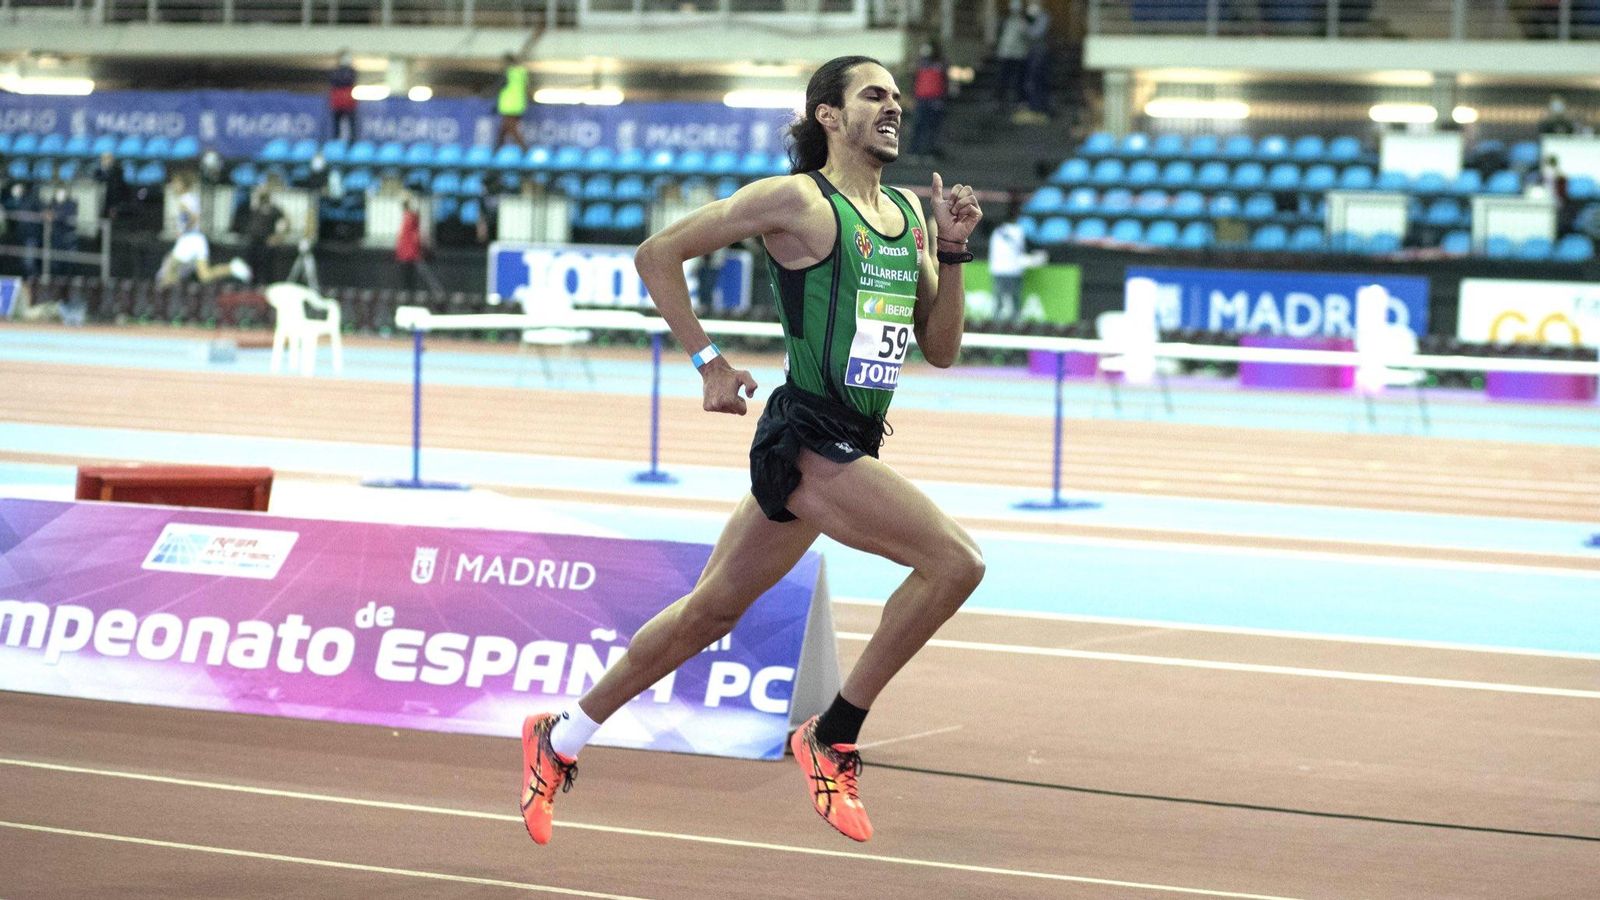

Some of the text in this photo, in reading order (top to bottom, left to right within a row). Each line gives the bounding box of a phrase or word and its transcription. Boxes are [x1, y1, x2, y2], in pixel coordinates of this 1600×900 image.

[860, 262, 913, 282] VILLARREAL
[878, 325, 909, 360] 59
[454, 552, 597, 591] MADRID
[355, 600, 396, 629] de
[703, 660, 796, 714] PC
